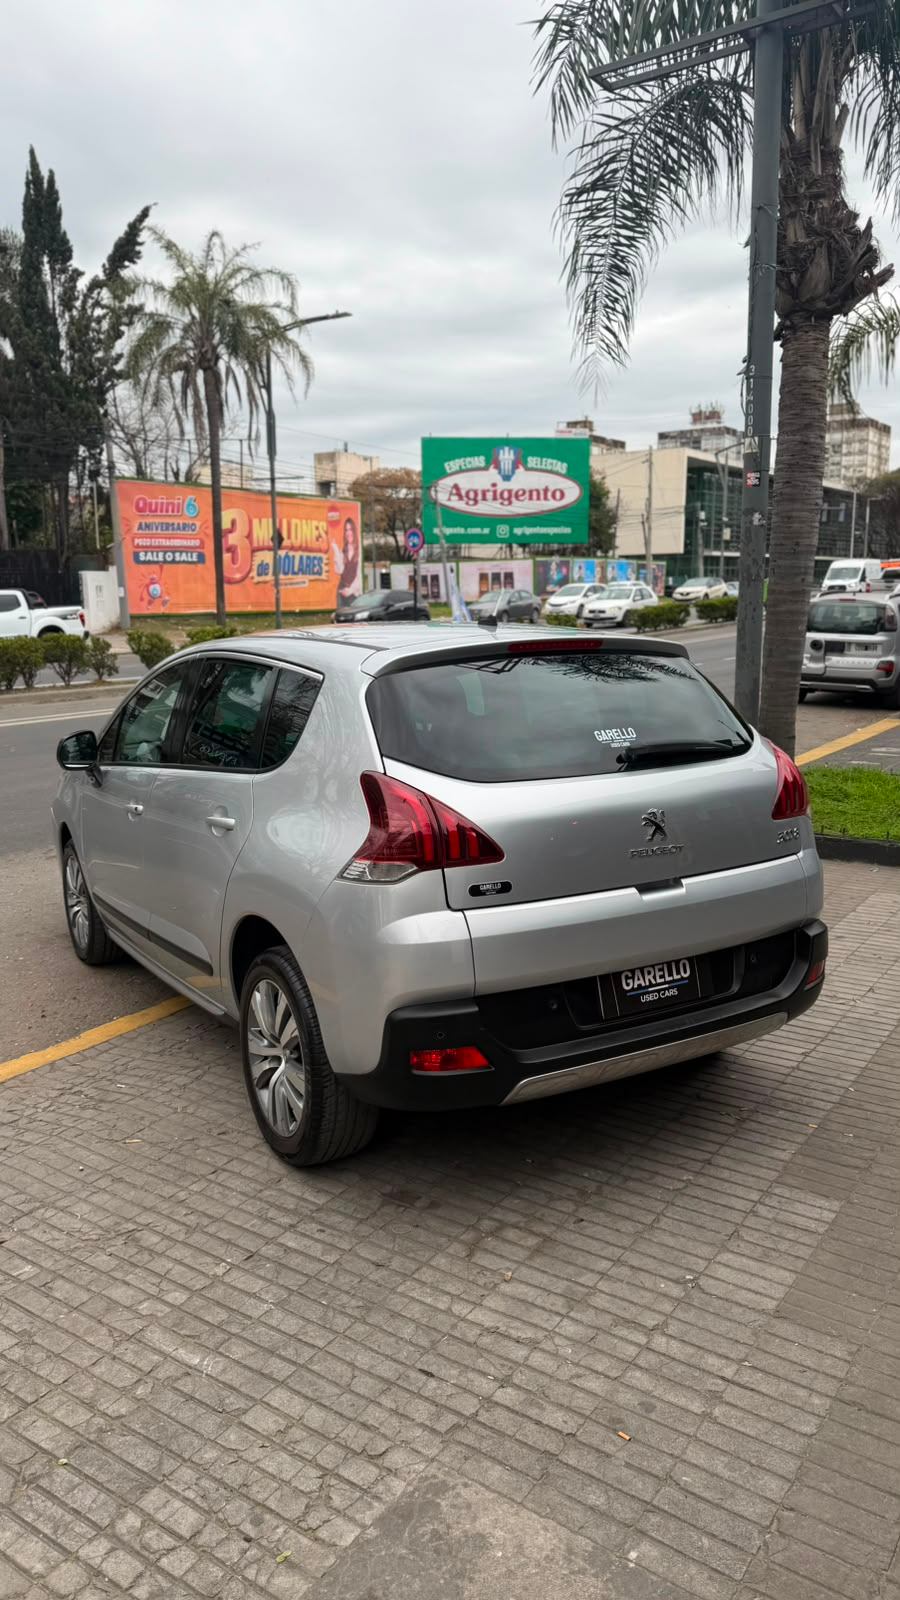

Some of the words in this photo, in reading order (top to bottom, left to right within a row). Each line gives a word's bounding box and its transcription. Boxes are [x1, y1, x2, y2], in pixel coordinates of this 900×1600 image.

[444, 455, 486, 473] ESPECIAS
[527, 456, 568, 474] SELECTAS
[447, 482, 566, 506] Agrigento
[133, 495, 182, 516] Quini
[184, 496, 198, 517] 6
[136, 521, 197, 532] ANIVERSARIO
[252, 517, 328, 548] MILONES
[222, 508, 252, 584] 3
[139, 551, 164, 561] SALE
[165, 552, 173, 561] O
[174, 551, 199, 561] SALE
[256, 560, 270, 577] de
[593, 727, 637, 742] GARELLO
[629, 844, 685, 859] PEUGEOT
[479, 882, 502, 891] GARELLO
[620, 959, 691, 990] GARELLO
[640, 992, 659, 1003] USED
[659, 987, 679, 999] CARS
